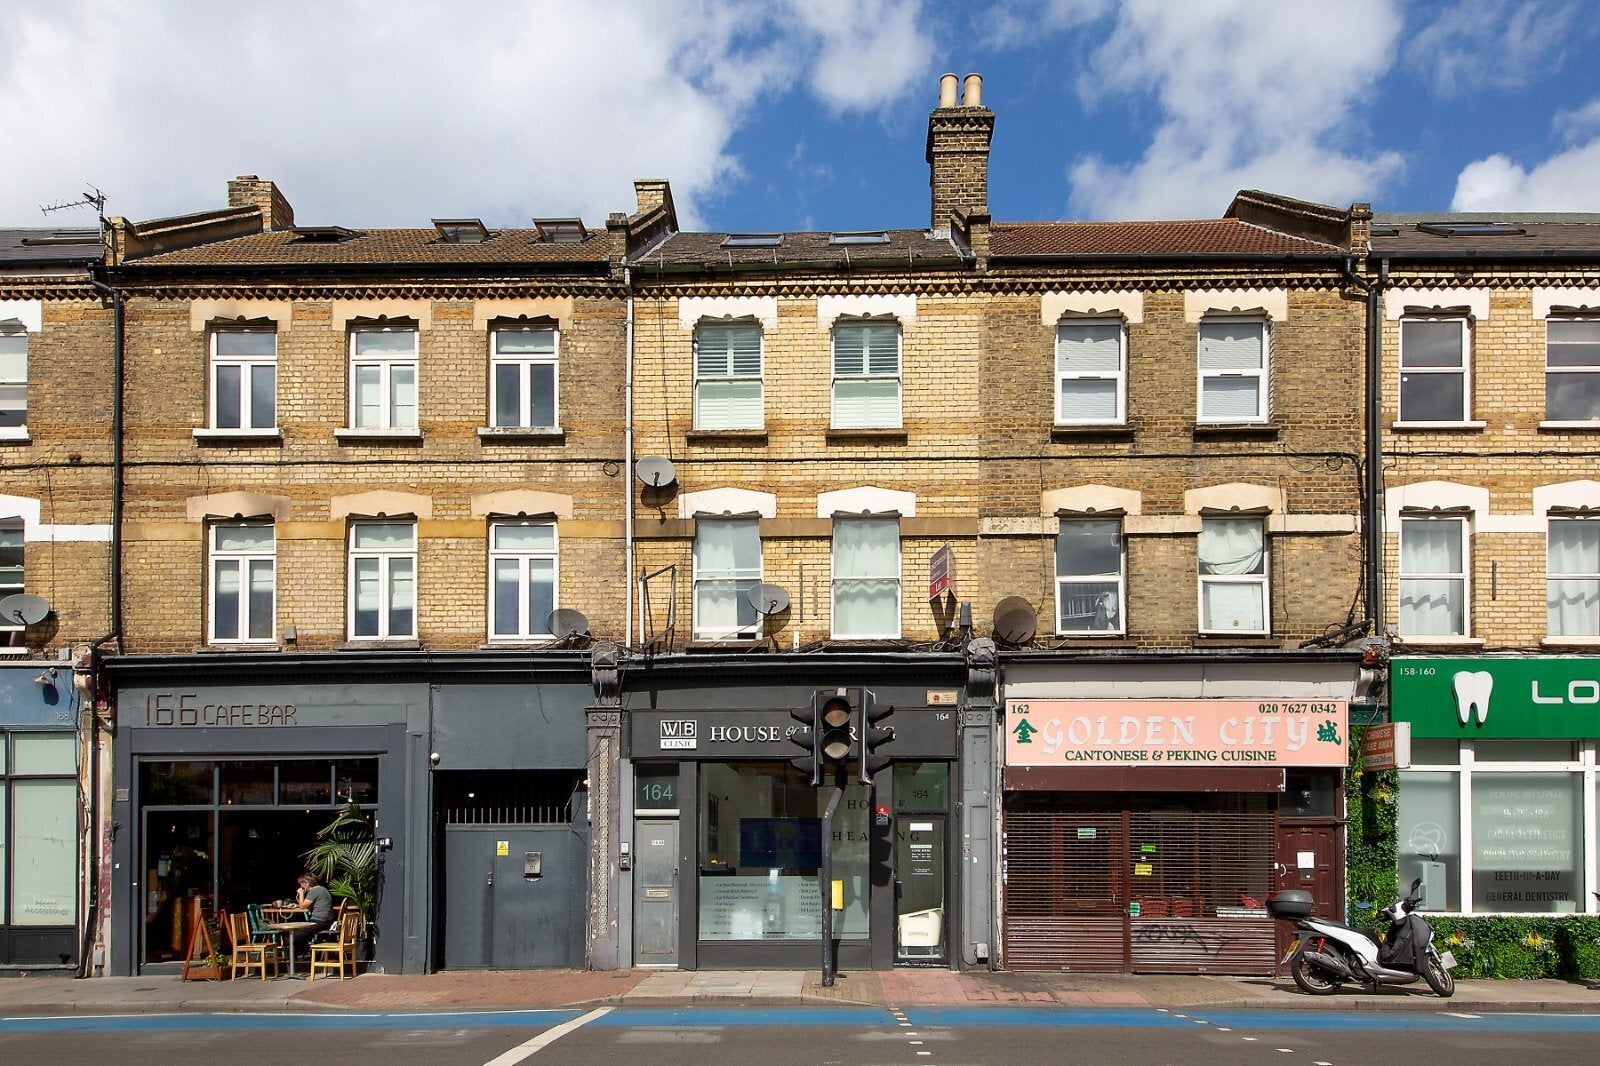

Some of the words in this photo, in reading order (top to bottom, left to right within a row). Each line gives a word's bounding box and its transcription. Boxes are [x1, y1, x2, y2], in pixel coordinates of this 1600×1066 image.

[1399, 667, 1436, 676] 158-160
[1531, 680, 1600, 704] LO
[147, 693, 198, 726] 166
[203, 704, 254, 725] CAFE
[258, 704, 298, 725] BAR
[1011, 704, 1030, 714] 162
[1258, 703, 1279, 713] 020
[1281, 703, 1308, 713] 7627
[1310, 703, 1337, 713] 0342
[935, 712, 950, 721] 164
[709, 726, 781, 742] HOUSE
[1012, 718, 1038, 744] 金
[1041, 715, 1196, 755] GOLDEN
[1218, 715, 1312, 752] CITY
[1064, 750, 1149, 761] CANTONESE
[1151, 750, 1164, 761] &
[1166, 750, 1218, 761] PEKING
[1221, 750, 1277, 761] CUISINE
[642, 784, 673, 801] 164
[912, 790, 929, 799] 164
[1486, 891, 1524, 902] GENERAL
[1525, 891, 1569, 902] DENTISTRY
